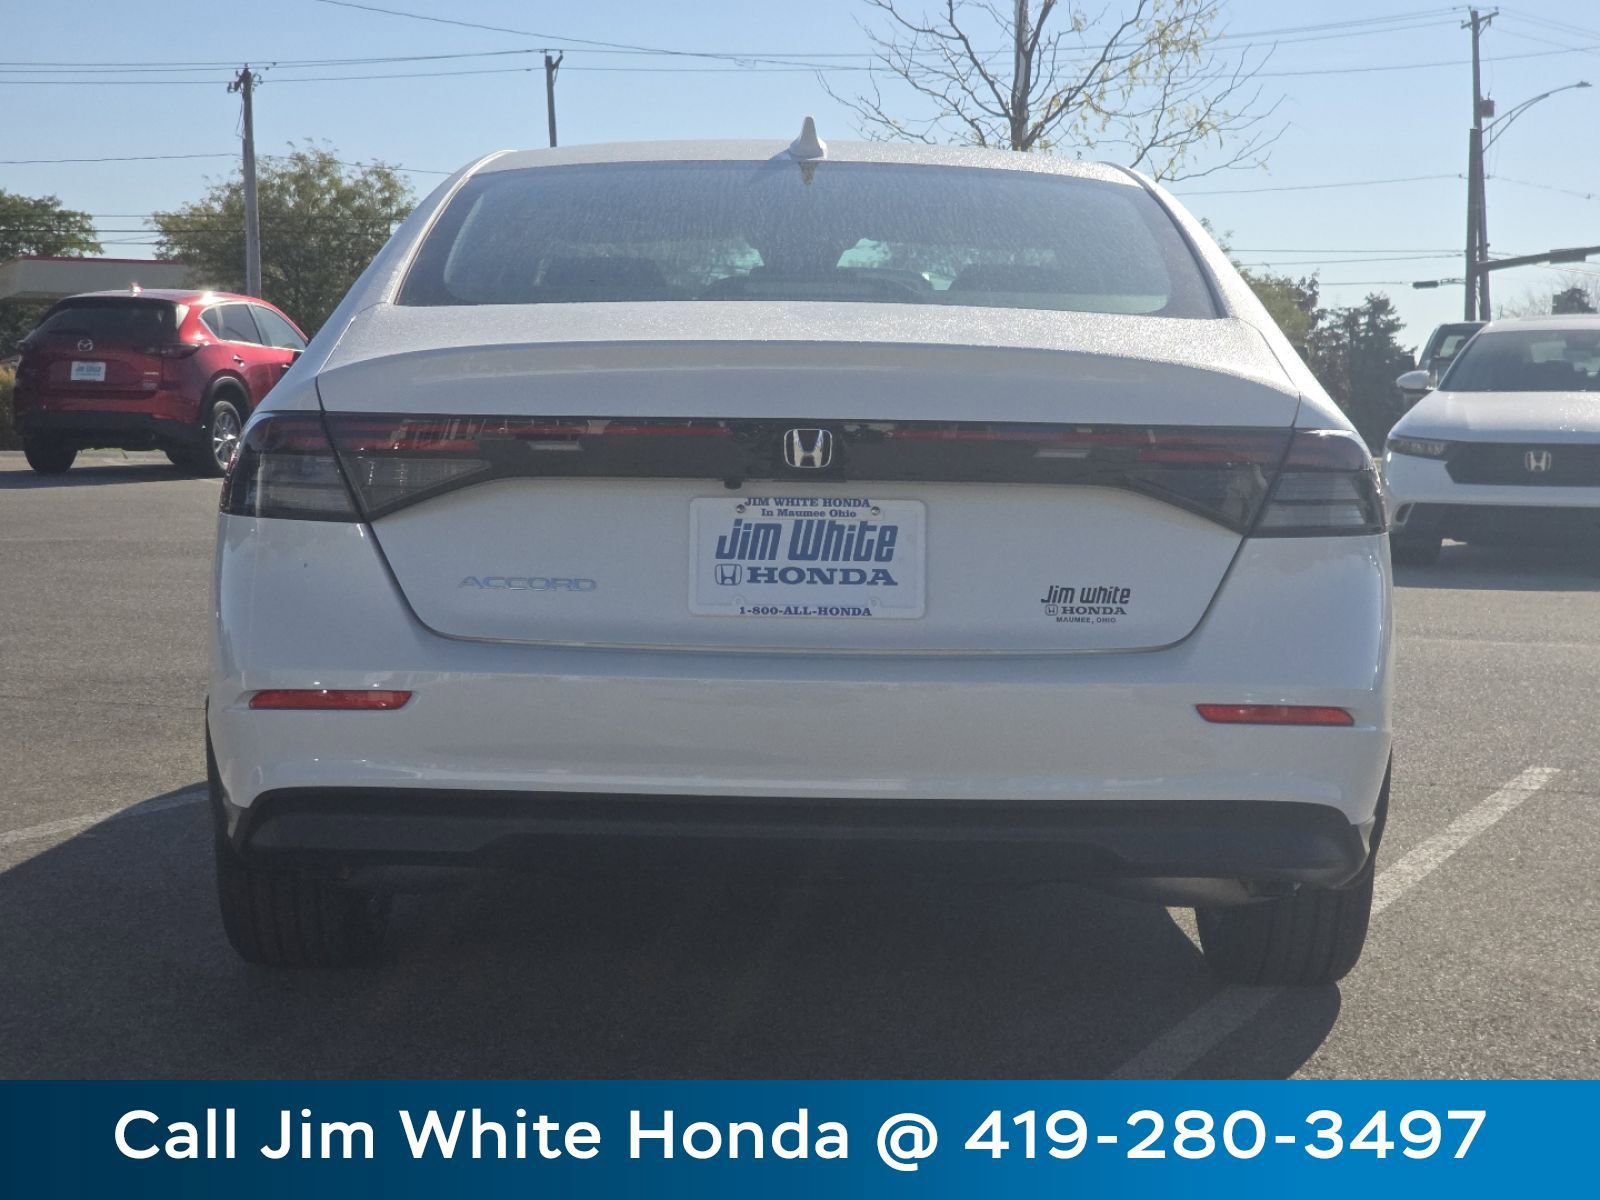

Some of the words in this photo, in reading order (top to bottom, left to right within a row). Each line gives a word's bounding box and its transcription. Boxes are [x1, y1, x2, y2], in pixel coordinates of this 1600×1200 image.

[744, 497, 769, 507] JIM
[773, 498, 819, 507] WHITE
[822, 499, 871, 508] HONDA
[761, 508, 774, 517] In
[777, 509, 826, 517] Maumee
[829, 509, 857, 518] Ohio
[787, 519, 898, 562] White
[747, 567, 898, 585] HONDA
[457, 575, 597, 592] ACCORD
[1040, 585, 1075, 604] Jim
[739, 606, 872, 617] 1-800-ALL-HONDA
[1061, 606, 1127, 615] HONDA
[1056, 616, 1094, 624] MAUMEE,
